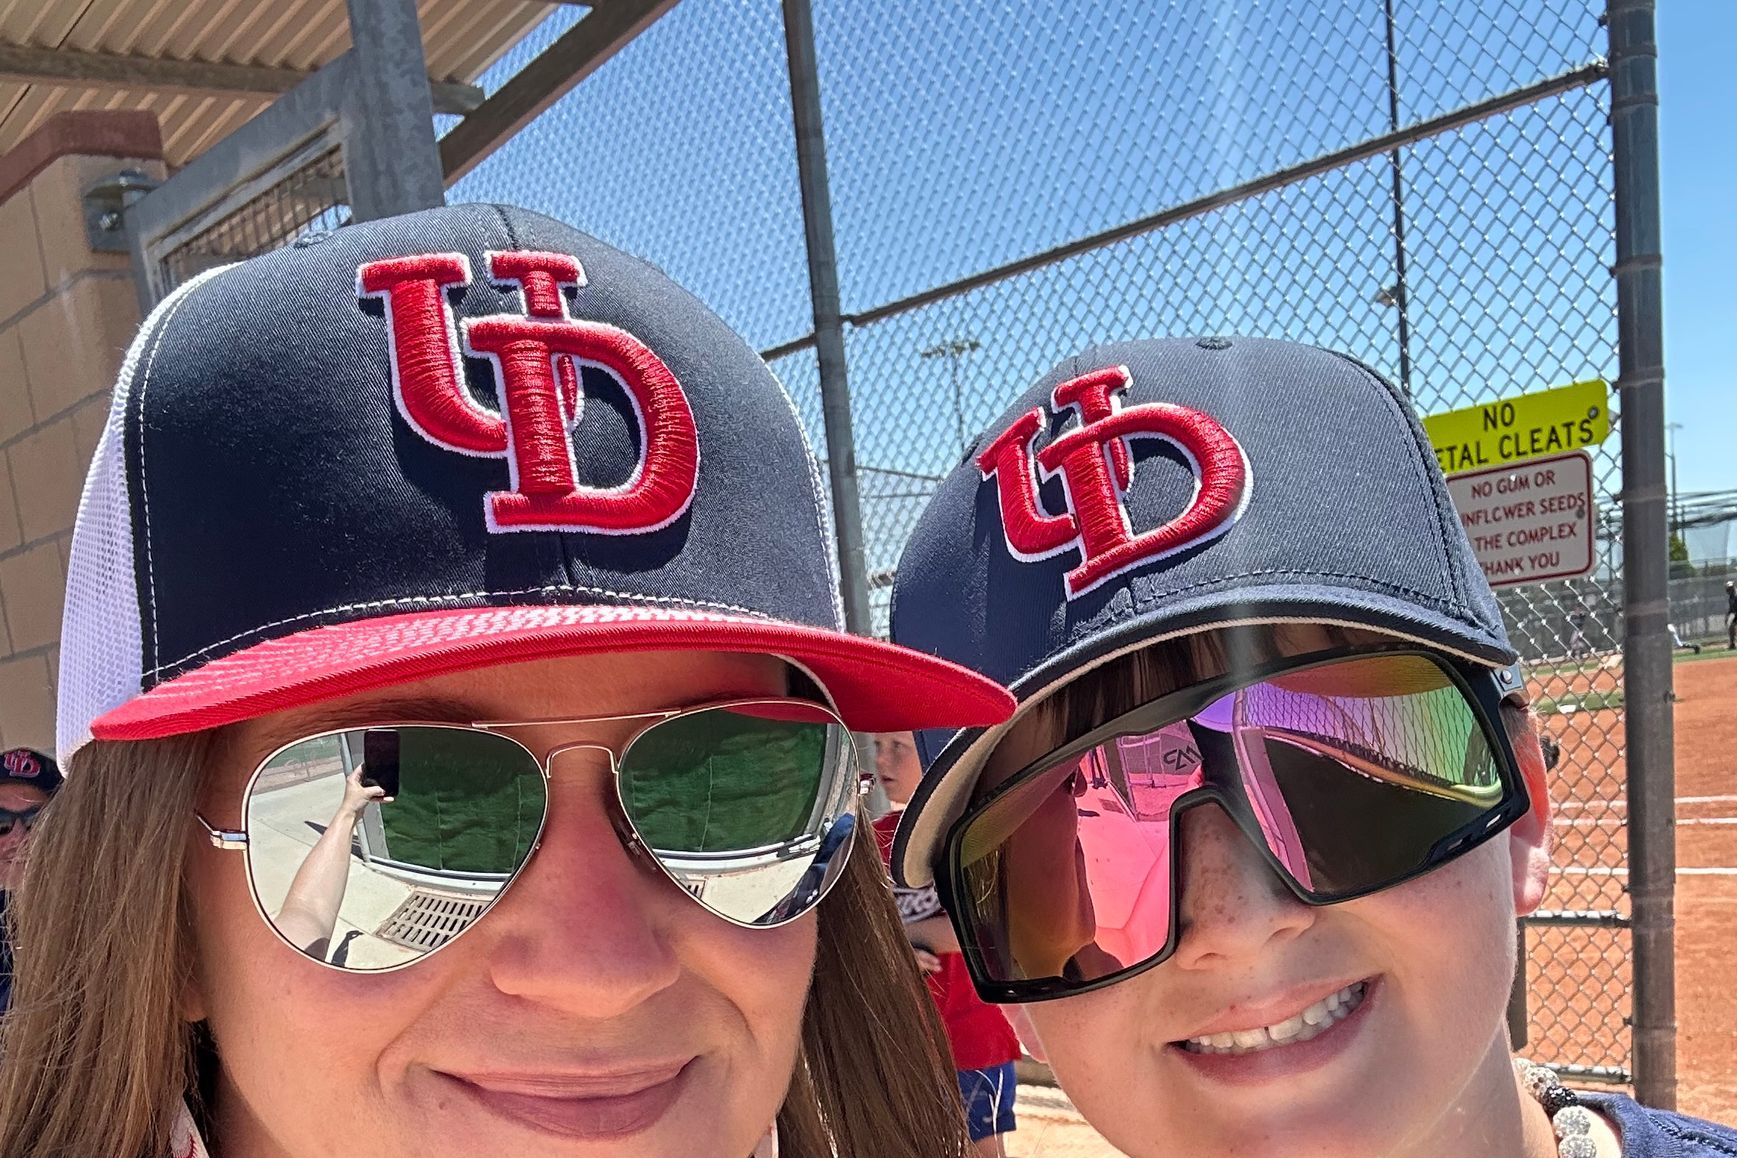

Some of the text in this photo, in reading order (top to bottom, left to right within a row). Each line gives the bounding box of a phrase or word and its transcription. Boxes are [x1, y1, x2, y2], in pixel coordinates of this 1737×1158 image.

[355, 250, 701, 536] UD
[1483, 402, 1515, 431] NO
[1499, 418, 1594, 459] CLEATS
[975, 364, 1254, 601] UD
[1471, 469, 1556, 499] NO GUM OR
[1540, 492, 1586, 515] SEEDS
[1474, 521, 1577, 552] THE COMPLEX
[1528, 551, 1560, 571] YOU
